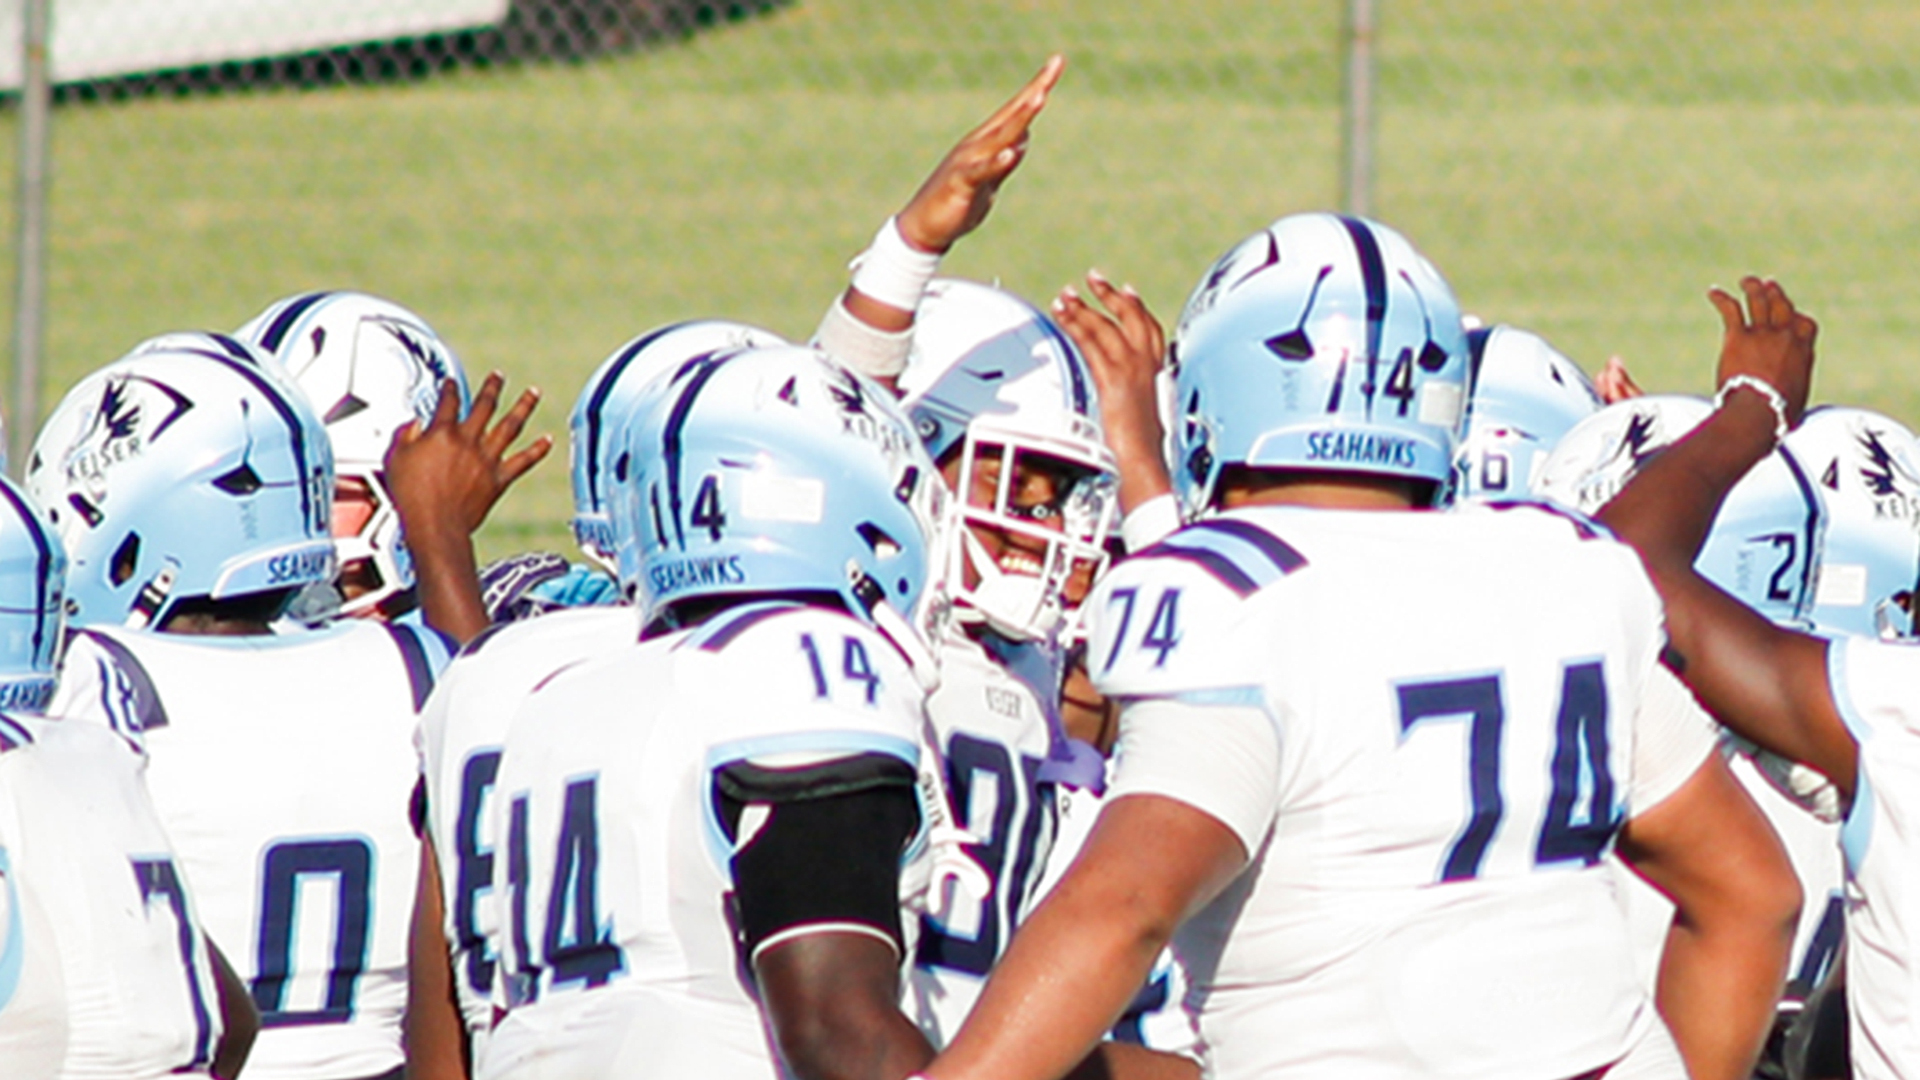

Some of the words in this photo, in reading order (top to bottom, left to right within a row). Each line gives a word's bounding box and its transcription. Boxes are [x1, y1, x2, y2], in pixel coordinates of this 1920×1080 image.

[64, 436, 144, 488] KEISER
[1305, 431, 1417, 469] SEAHAWKS
[1873, 497, 1920, 532] KEIS
[650, 555, 746, 596] SEAHAWKS
[1767, 532, 1797, 601] 2
[1103, 586, 1182, 673] 74
[798, 632, 881, 705] 14
[1389, 654, 1628, 884] 74
[506, 768, 632, 1008] 14
[252, 832, 379, 1031] 0
